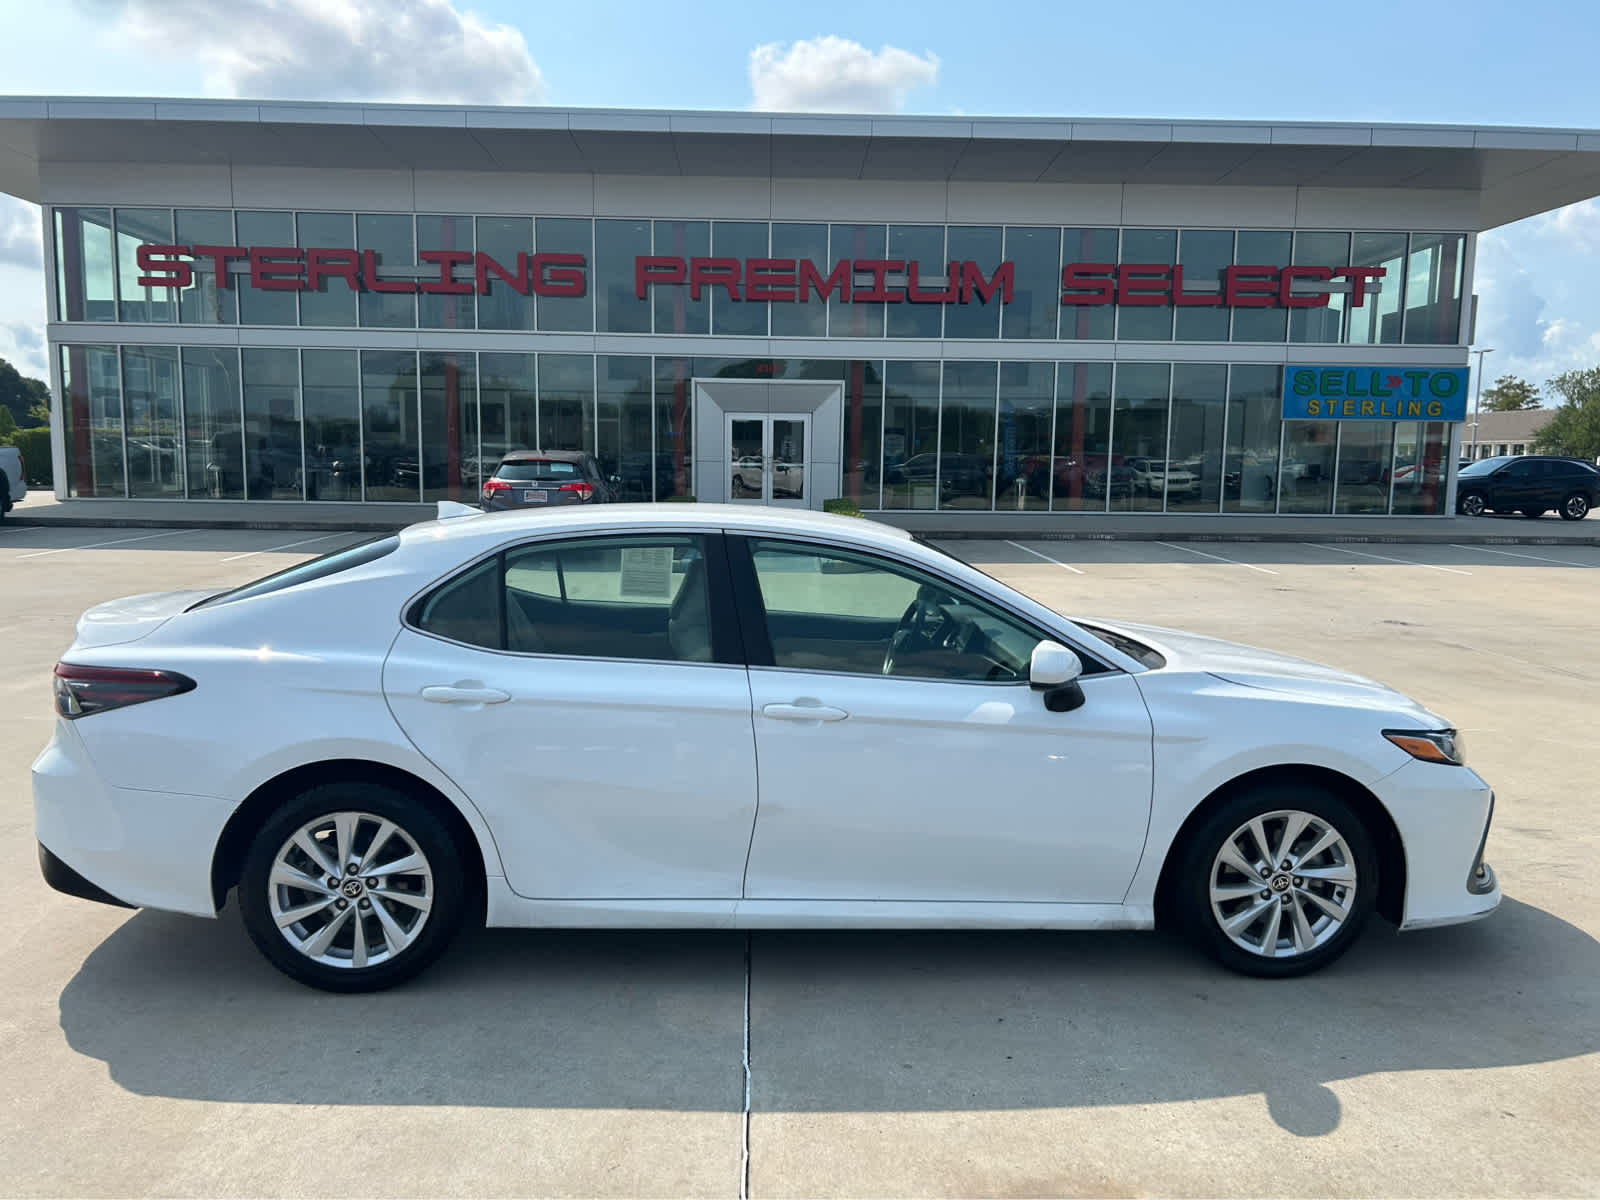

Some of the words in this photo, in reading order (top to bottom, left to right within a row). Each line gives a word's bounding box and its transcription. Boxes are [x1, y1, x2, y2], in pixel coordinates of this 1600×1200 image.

[136, 244, 587, 298] STERLING
[635, 256, 1014, 304] PREMIUM
[1062, 263, 1386, 308] SELECT
[1294, 369, 1393, 397] SELL
[1404, 370, 1459, 398] TO
[1308, 399, 1442, 417] STERLING
